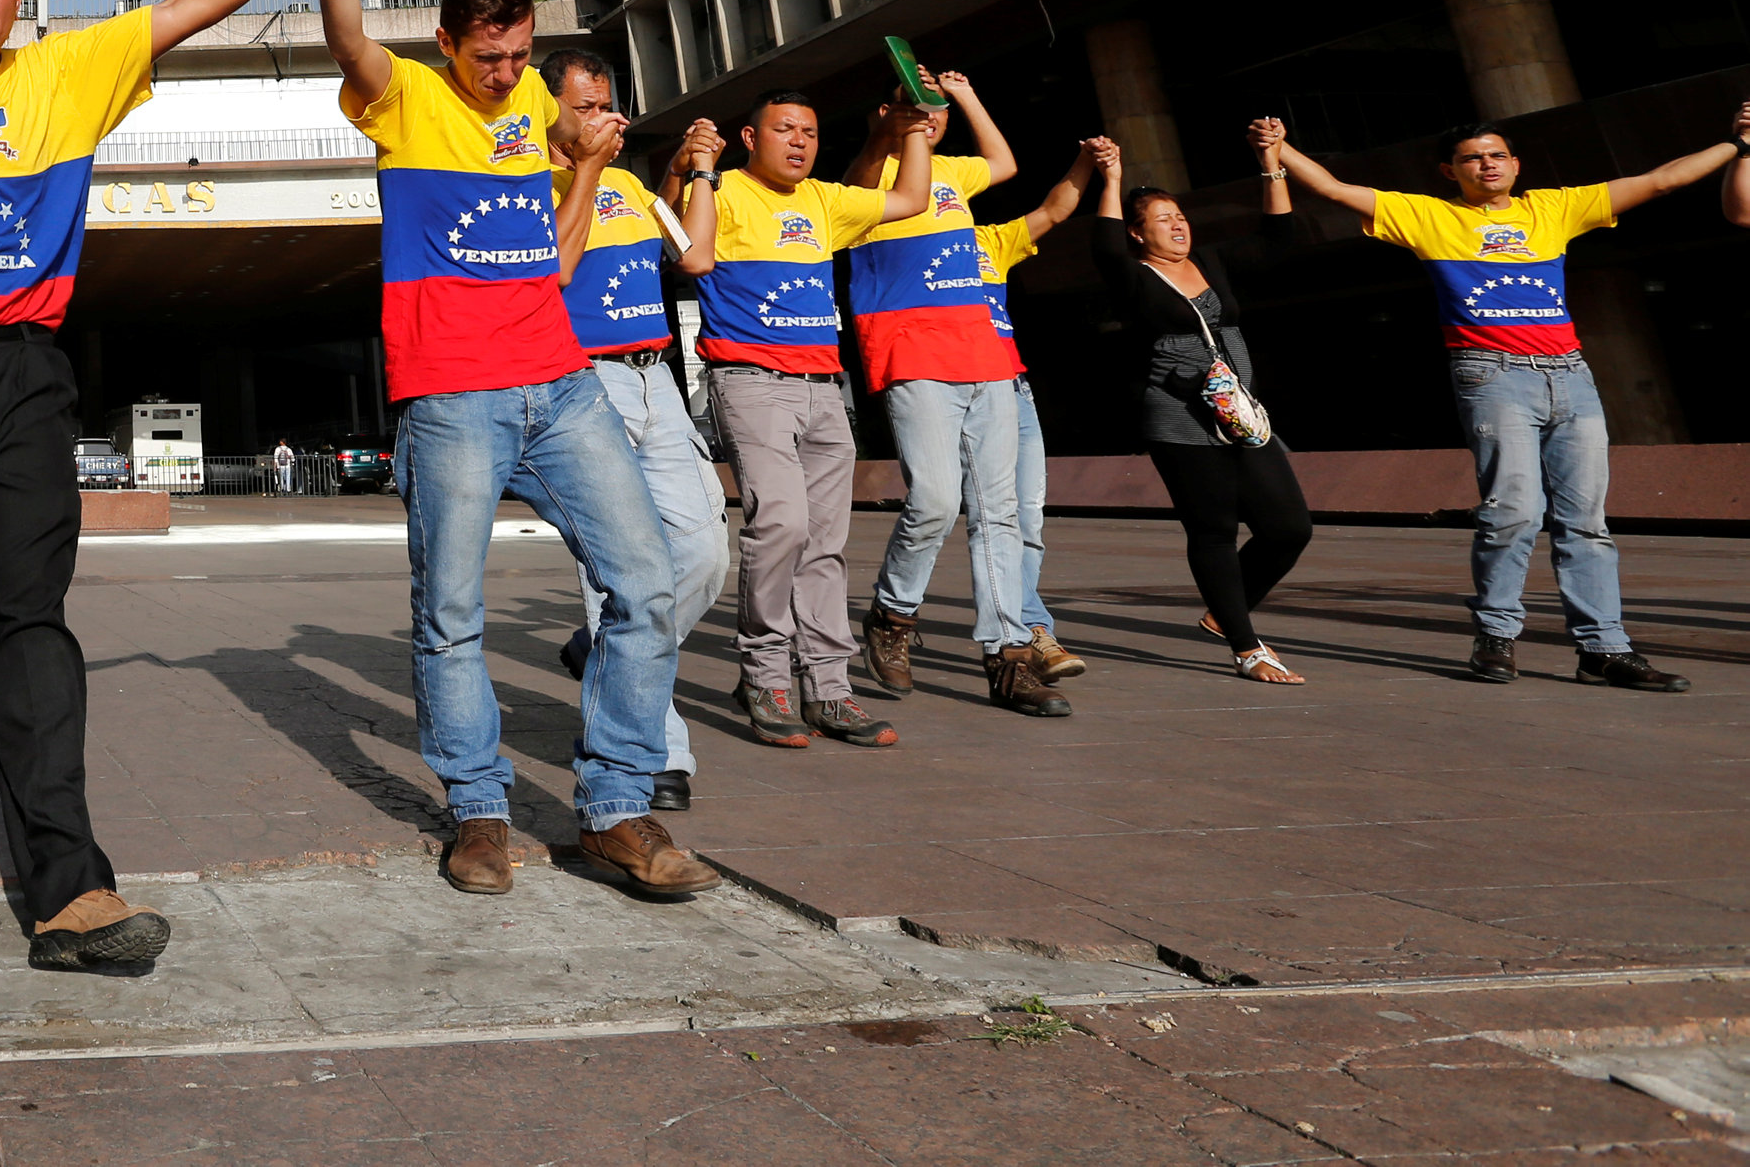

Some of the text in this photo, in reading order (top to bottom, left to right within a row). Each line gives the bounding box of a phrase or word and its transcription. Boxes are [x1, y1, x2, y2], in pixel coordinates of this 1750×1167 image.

[86, 181, 217, 214] CAS
[449, 246, 558, 263] VENEZUELA
[606, 302, 665, 321] VENEZU
[760, 316, 837, 327] VENEZUE
[86, 462, 118, 470] CHERY
